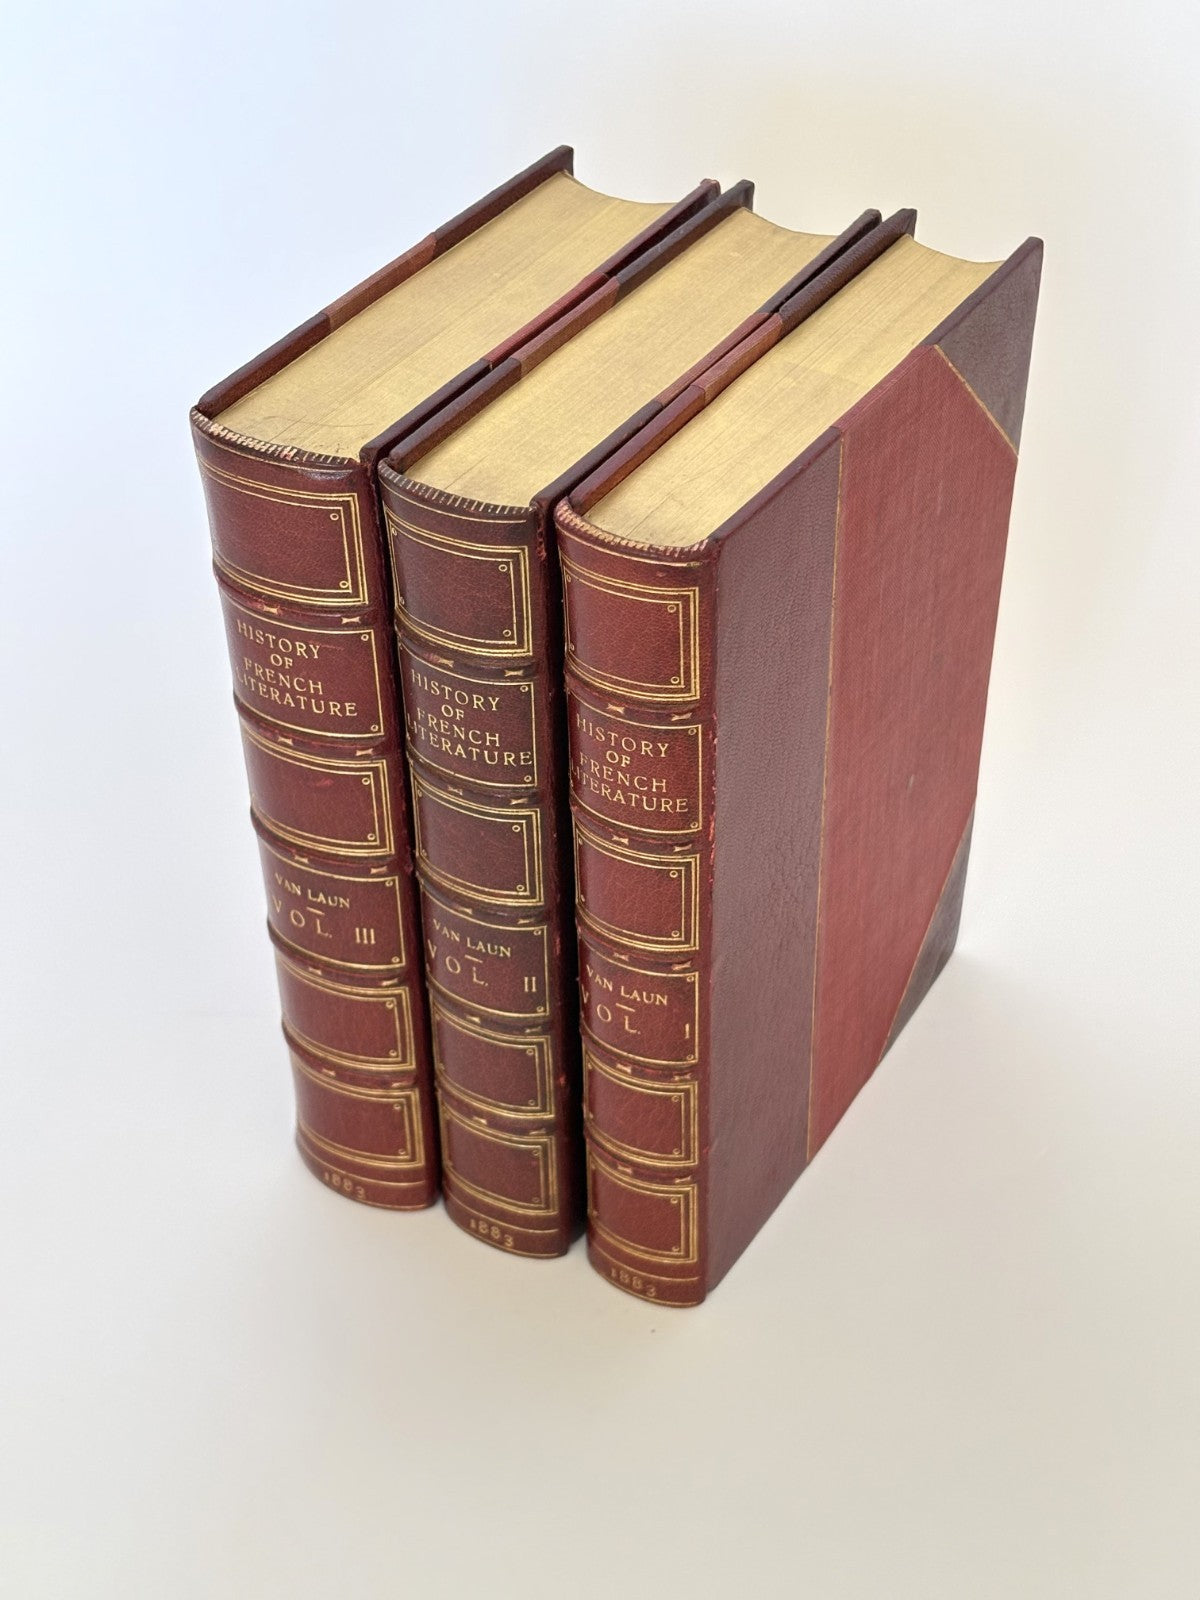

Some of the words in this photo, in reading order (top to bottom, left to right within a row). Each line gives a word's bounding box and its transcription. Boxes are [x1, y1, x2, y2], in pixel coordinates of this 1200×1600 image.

[236, 619, 321, 659] HISTORY
[244, 657, 323, 695] FRENCH
[270, 654, 293, 669] OF
[235, 666, 358, 717] LITERATURE
[411, 669, 500, 711] HISTORY
[417, 707, 500, 747] FRENCH
[441, 704, 465, 721] OF
[407, 713, 533, 767] LITERATURE
[576, 713, 669, 758] HISTORY
[579, 752, 667, 793] FRENCH
[606, 750, 631, 767] OF
[571, 760, 689, 813] LITERATURE
[275, 873, 302, 896] VAN
[308, 889, 350, 909] LAUN
[355, 927, 376, 945] III
[433, 918, 460, 942] VAN
[466, 937, 511, 958] LAUN
[524, 976, 537, 993] II
[586, 964, 613, 992] VAN
[620, 985, 668, 1006] LAUN
[684, 1023, 690, 1039] I
[470, 1219, 515, 1247] 1883
[611, 1268, 657, 1297] 1883
